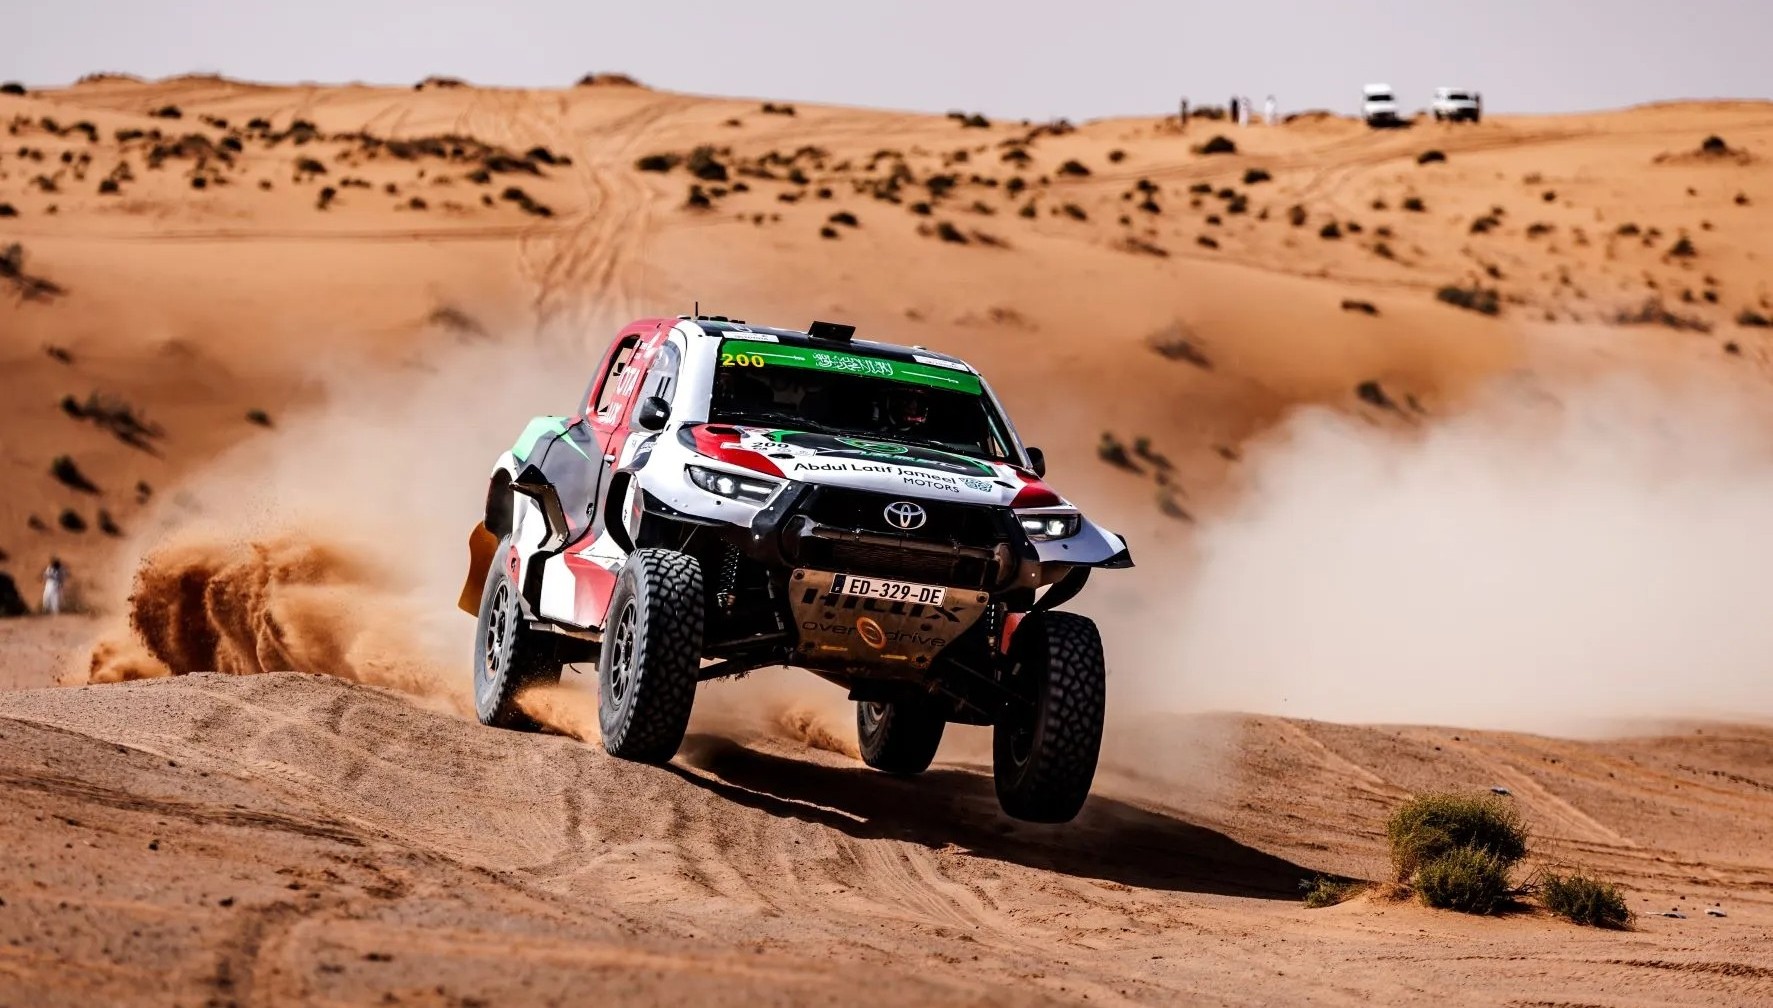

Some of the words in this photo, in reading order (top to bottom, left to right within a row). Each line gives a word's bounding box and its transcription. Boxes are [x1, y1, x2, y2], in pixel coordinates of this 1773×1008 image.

[722, 353, 765, 368] 200
[794, 463, 848, 472] Abdul
[851, 464, 894, 474] Latif
[898, 467, 957, 485] Jameel
[903, 477, 960, 494] MOTORS
[848, 578, 942, 605] ED-329-DE
